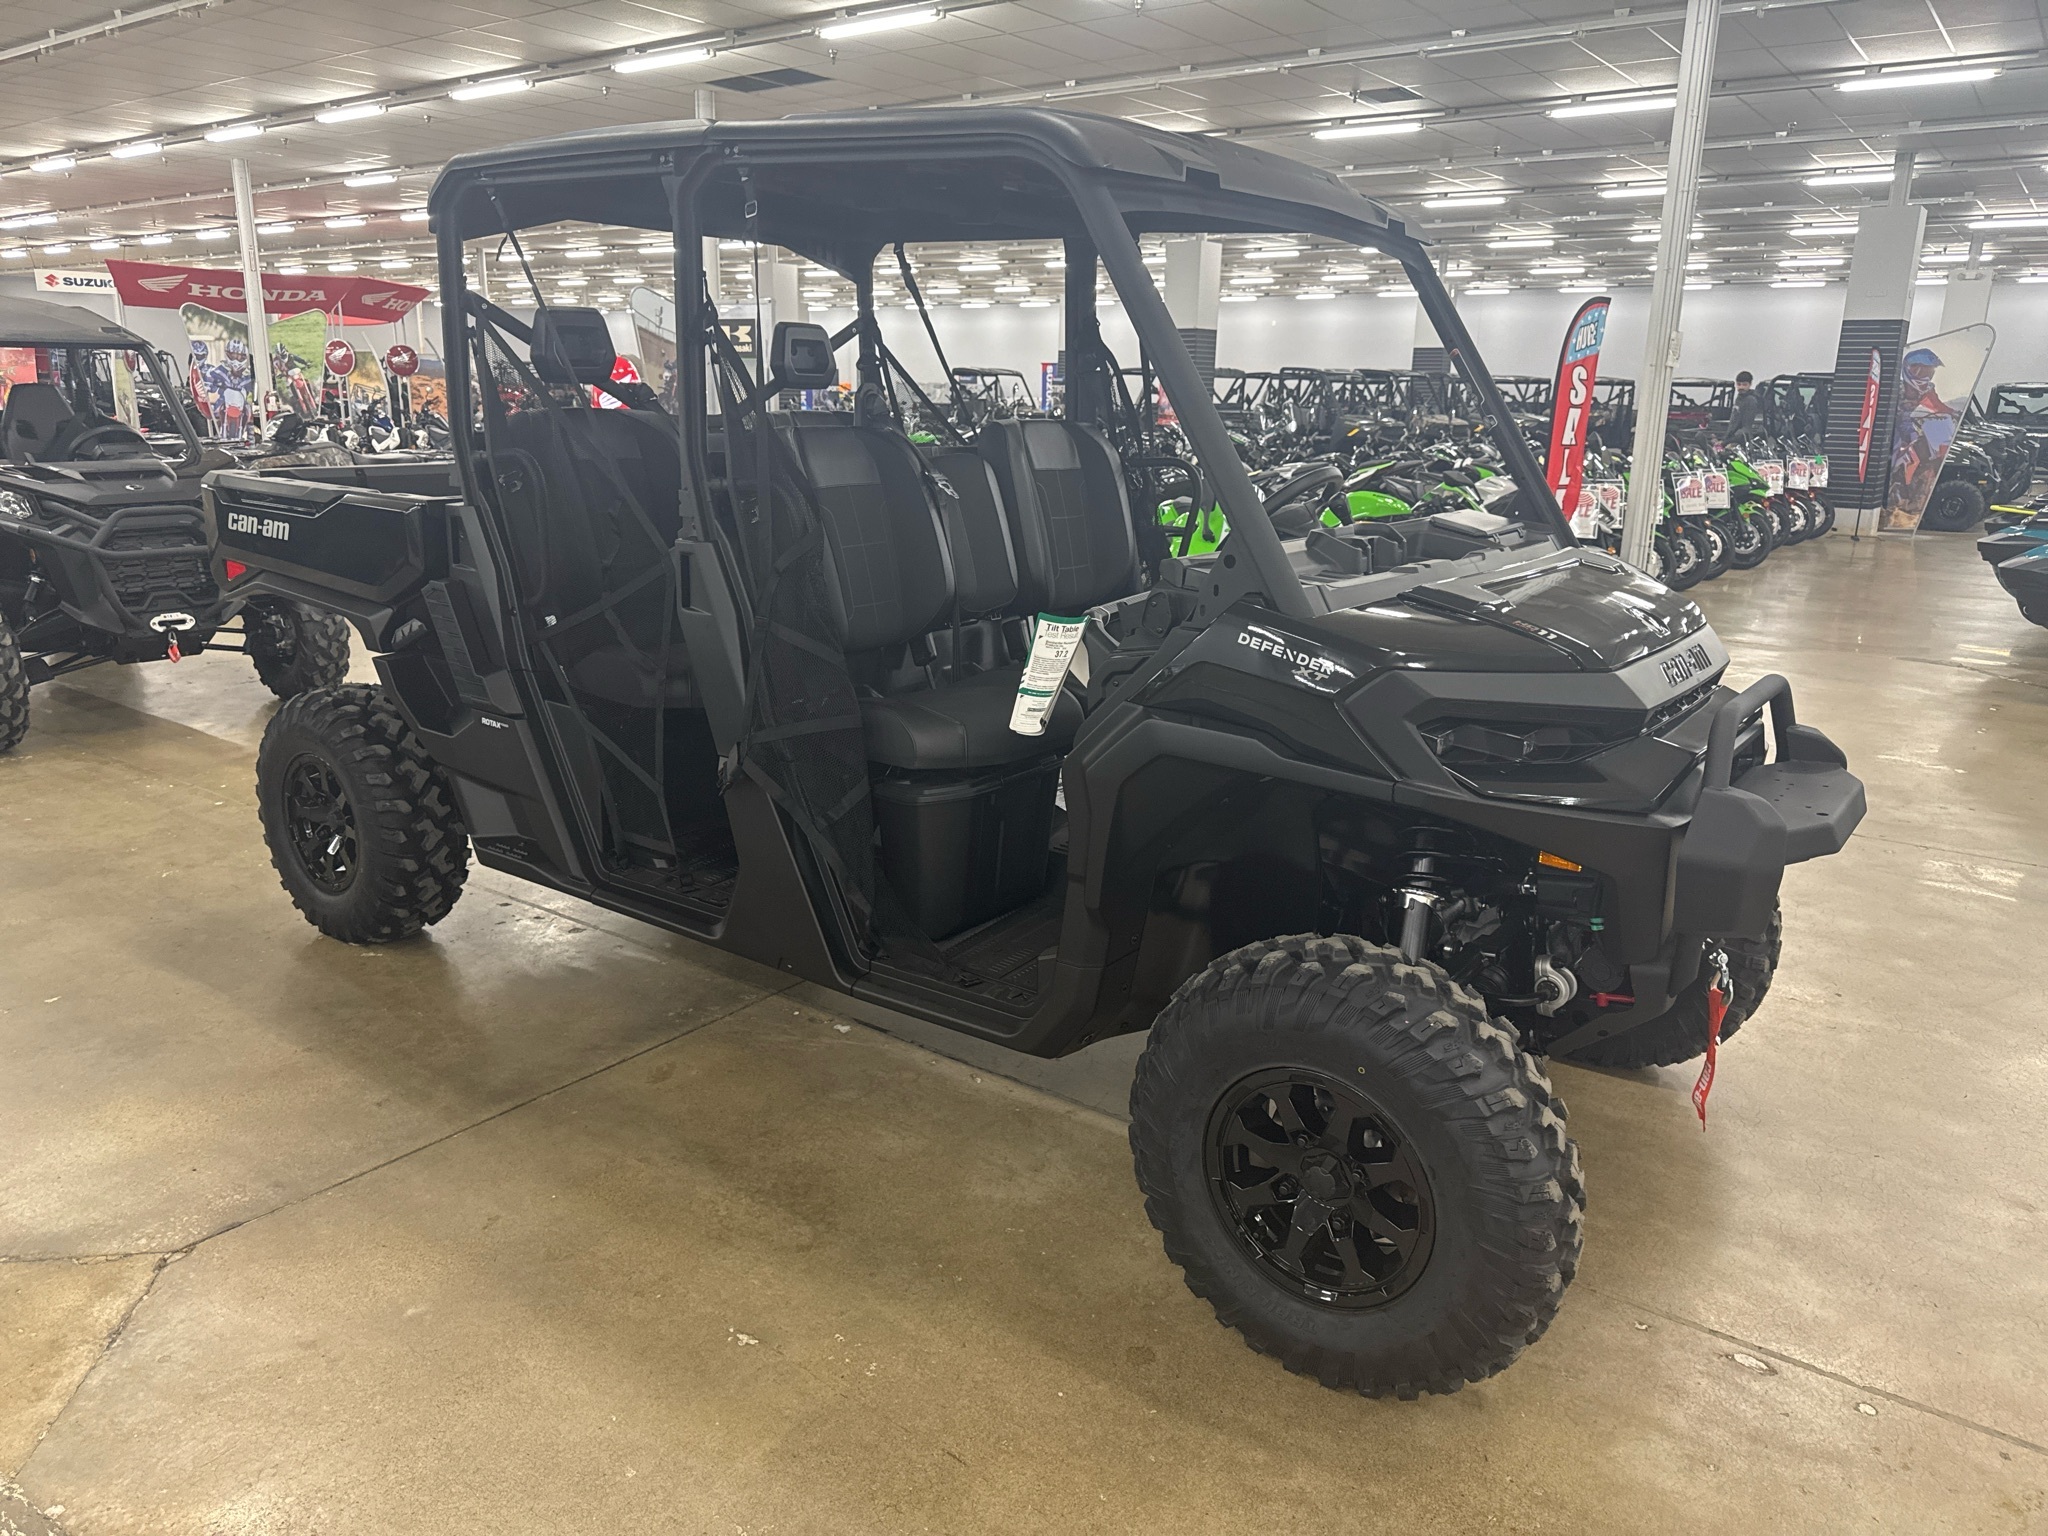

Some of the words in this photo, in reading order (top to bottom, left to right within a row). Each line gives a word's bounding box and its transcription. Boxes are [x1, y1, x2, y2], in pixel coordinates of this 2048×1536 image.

[62, 276, 115, 289] SUZUK
[187, 282, 328, 302] HONDA
[382, 297, 417, 312] HON
[1680, 486, 1703, 499] SALE
[1706, 480, 1727, 493] SALE
[227, 512, 291, 541] can-am
[1046, 622, 1060, 632] Tilt
[1061, 624, 1080, 633] Table
[1054, 650, 1069, 659] 37.2
[1237, 631, 1336, 676] DEFENDER
[1659, 643, 1713, 688] can-am
[1290, 665, 1330, 681] XT
[481, 716, 509, 730] ROTAX
